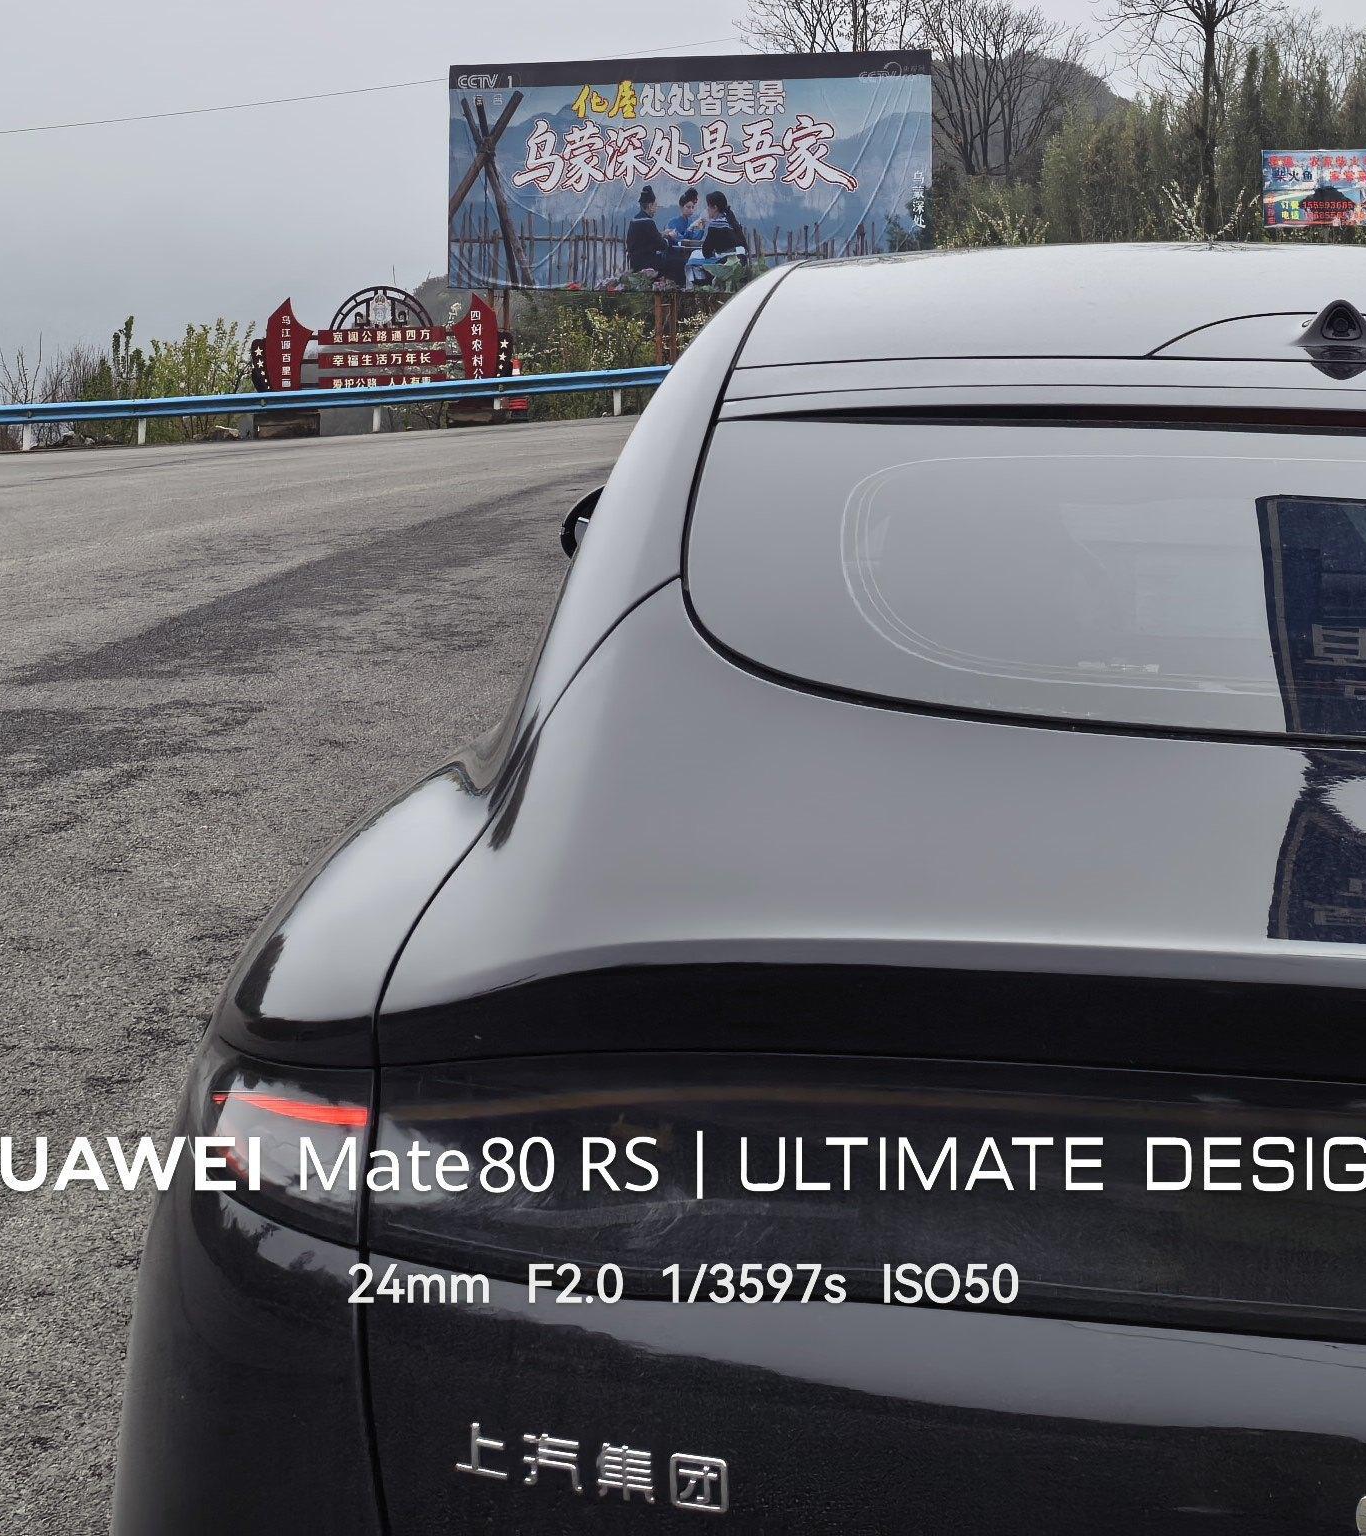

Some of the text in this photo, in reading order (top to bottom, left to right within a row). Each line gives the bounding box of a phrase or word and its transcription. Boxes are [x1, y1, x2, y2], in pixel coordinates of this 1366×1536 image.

[457, 73, 499, 89] CCTV
[571, 79, 786, 119] 化屋处处皆美景
[511, 114, 859, 193] 乌蒙深处是吾家
[1273, 168, 1313, 182] 柴火鱼
[912, 170, 926, 229] 乌蒙深处
[332, 329, 431, 344] 宽阔公路通四方
[332, 352, 431, 367] 幸福生活万年长
[455, 1422, 728, 1513] 上汽集团
